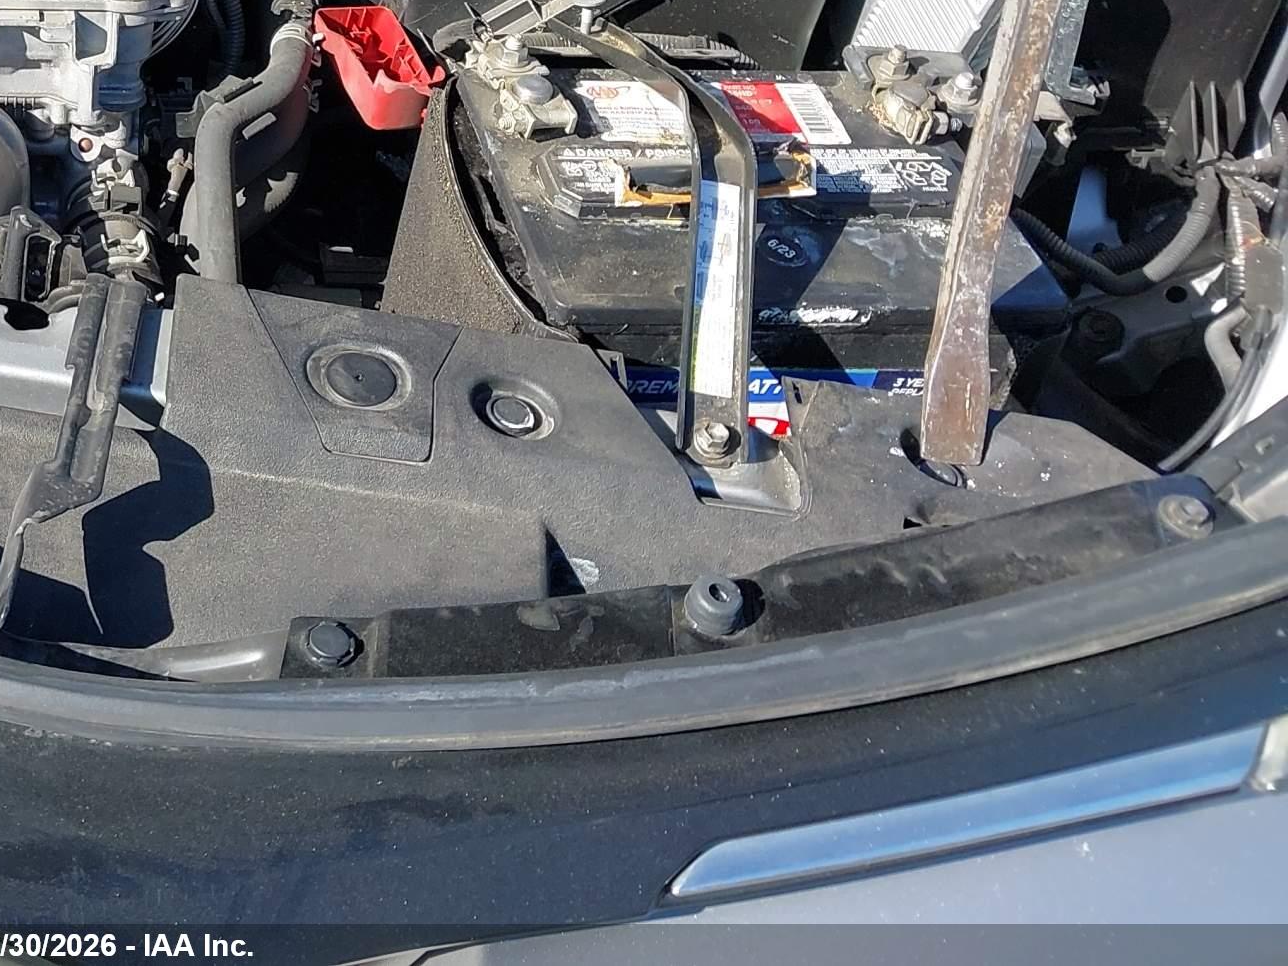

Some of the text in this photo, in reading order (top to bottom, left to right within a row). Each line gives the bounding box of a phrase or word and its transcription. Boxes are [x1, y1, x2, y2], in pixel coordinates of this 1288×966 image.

[575, 148, 632, 159] DANGER
[767, 238, 796, 259] 6/23
[906, 378, 925, 387] YE
